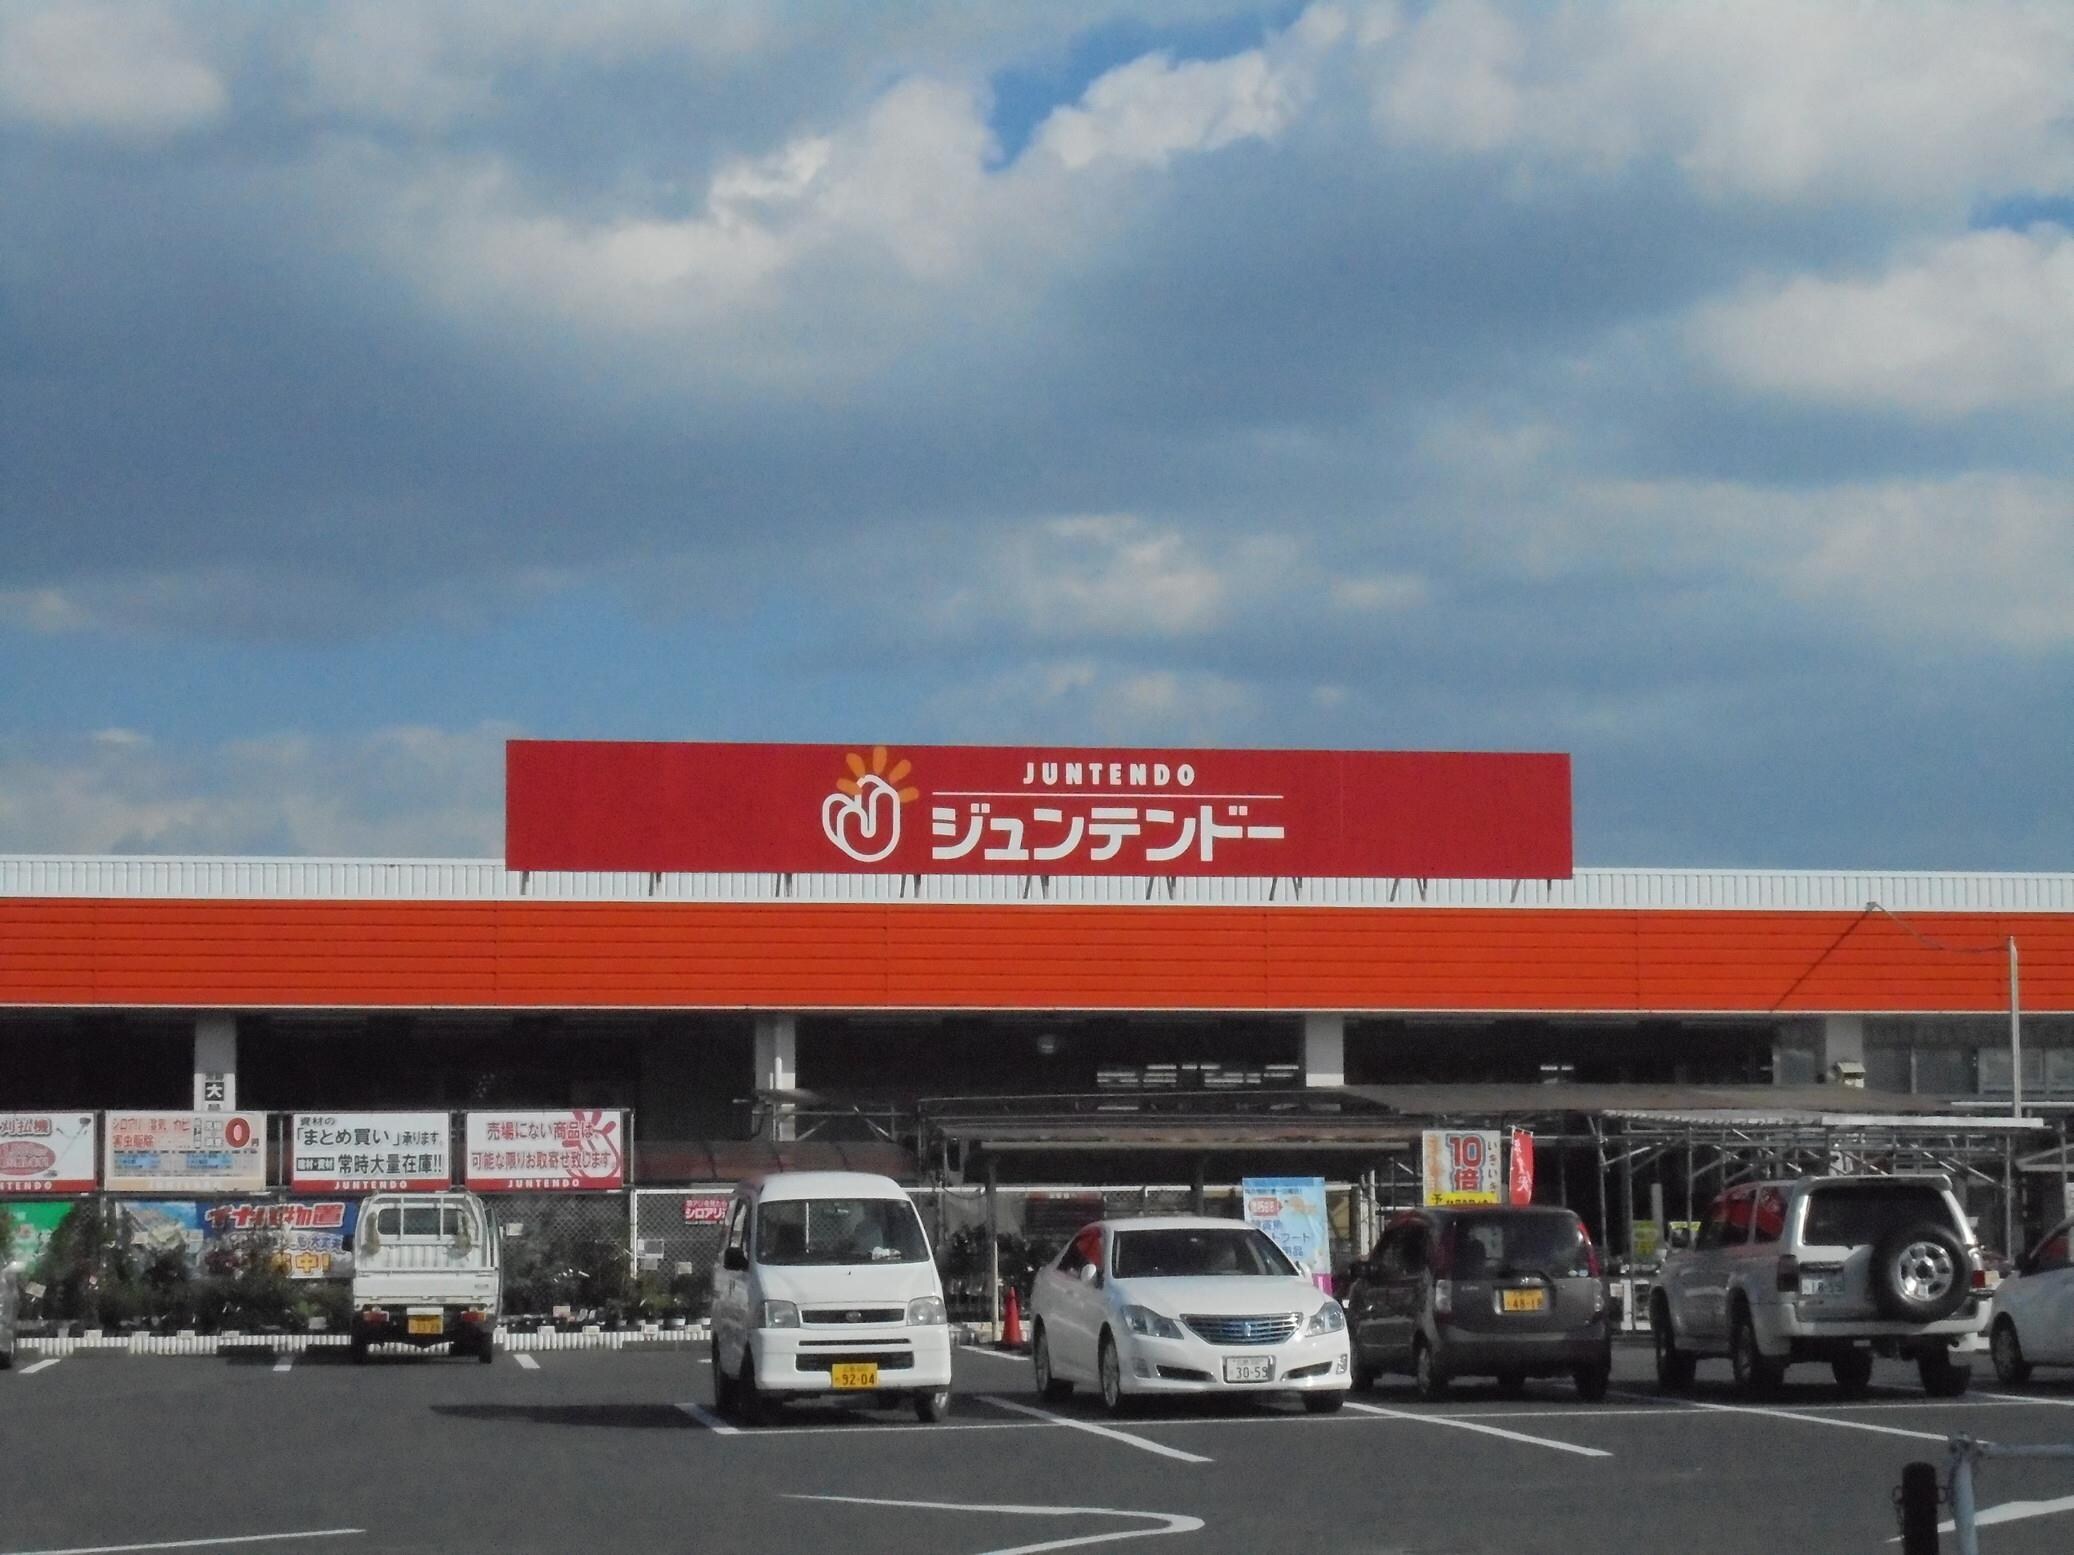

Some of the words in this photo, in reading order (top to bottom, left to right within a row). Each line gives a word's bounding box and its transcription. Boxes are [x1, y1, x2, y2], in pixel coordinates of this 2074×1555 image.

[1022, 762, 1196, 787] JUNTENDO
[931, 803, 1286, 862] ジュンテンドー
[300, 1116, 336, 1126] 資材の
[334, 1180, 408, 1190] JUNTENDO
[507, 1179, 580, 1188] JUNTENDO
